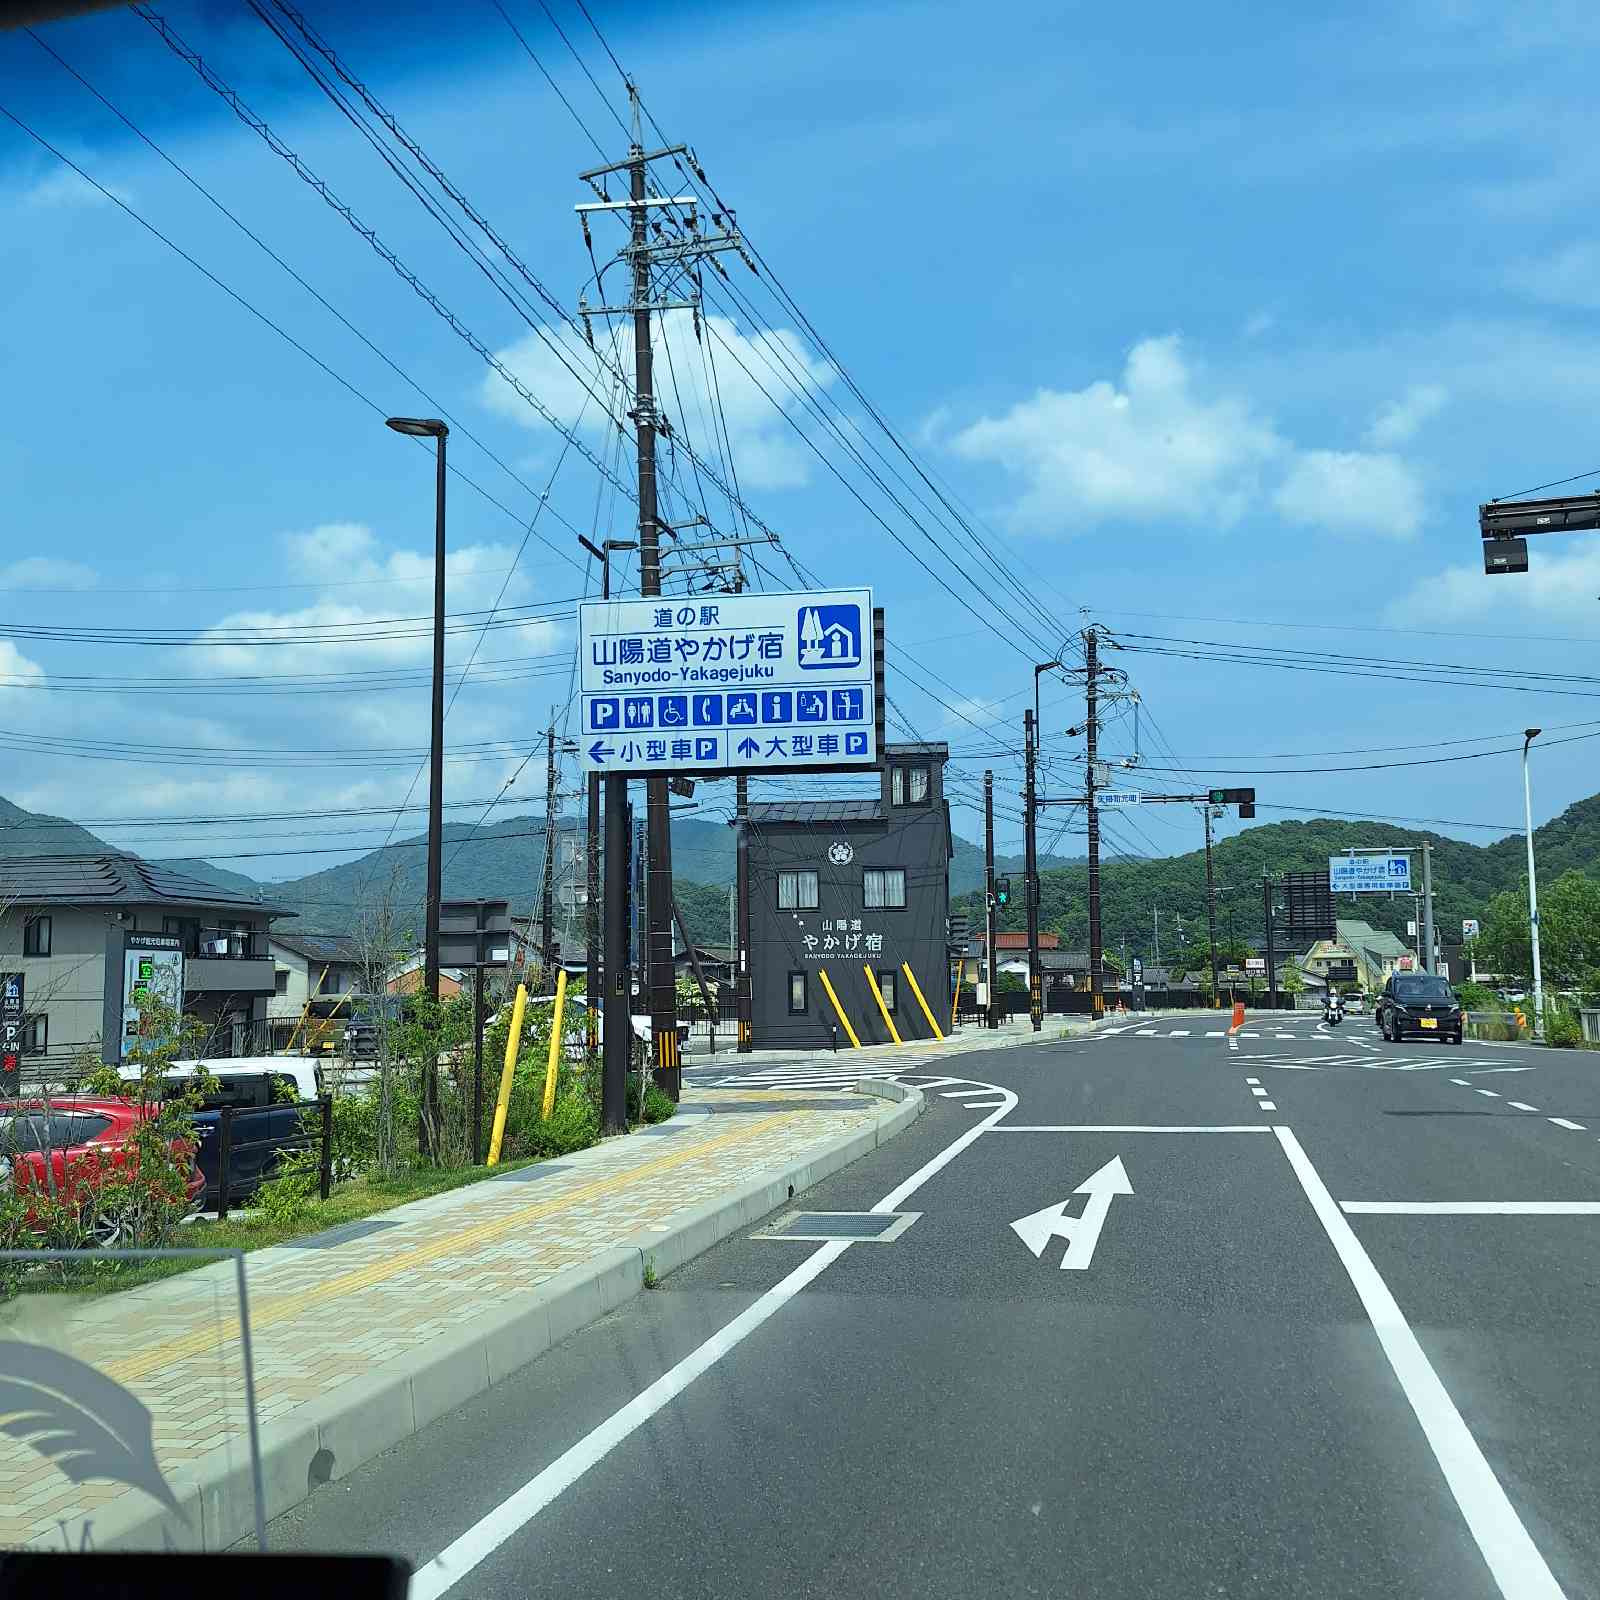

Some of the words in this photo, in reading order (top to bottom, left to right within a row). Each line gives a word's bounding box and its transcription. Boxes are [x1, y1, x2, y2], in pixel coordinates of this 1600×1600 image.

[654, 606, 720, 627] 道の駅
[592, 633, 784, 666] 山陽道やかげ宿
[603, 664, 774, 685] Sanyodo-Yakagejuku
[597, 703, 613, 725] P
[620, 740, 693, 762] 小型車
[765, 734, 839, 758] 大型車
[822, 919, 862, 931] 山陽道
[802, 933, 883, 951] やかげ宿
